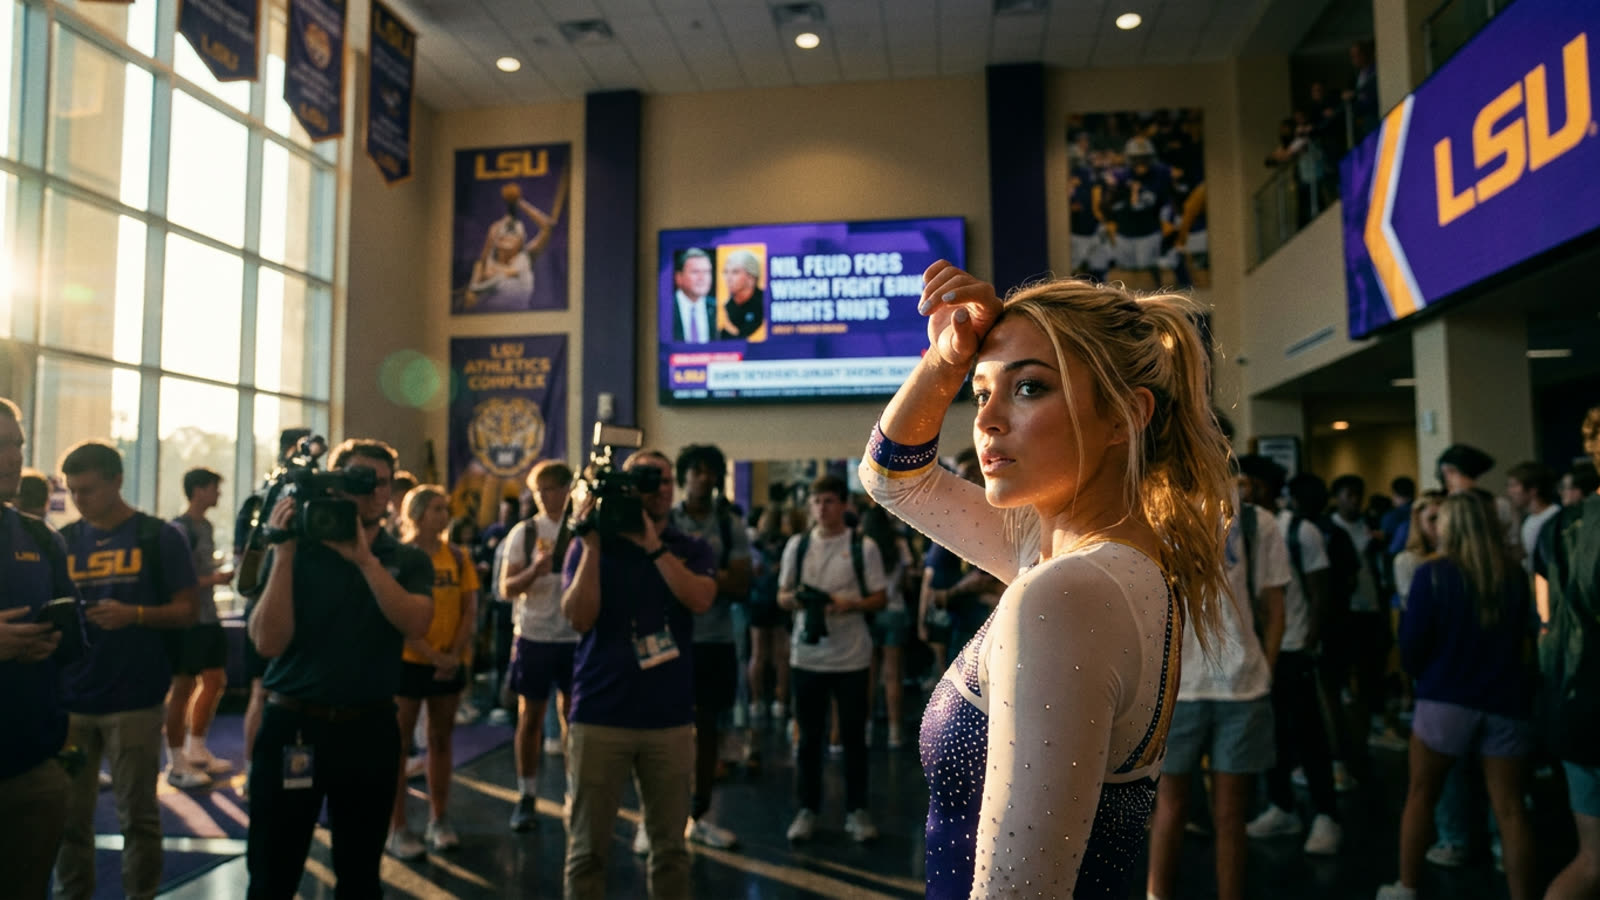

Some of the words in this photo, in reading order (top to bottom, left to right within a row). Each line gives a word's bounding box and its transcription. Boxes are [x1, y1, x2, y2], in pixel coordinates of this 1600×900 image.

[1434, 32, 1592, 227] LSU
[475, 150, 549, 179] LSU
[770, 256, 802, 279] NIL
[803, 253, 852, 277] FEUD
[854, 252, 903, 275] FOES
[770, 278, 830, 300] WHICH
[832, 276, 883, 298] FIGHT
[490, 343, 524, 359] LSU
[464, 357, 551, 374] ATHLETICS
[468, 374, 546, 390] COMPLEX
[66, 548, 143, 580] LSU
